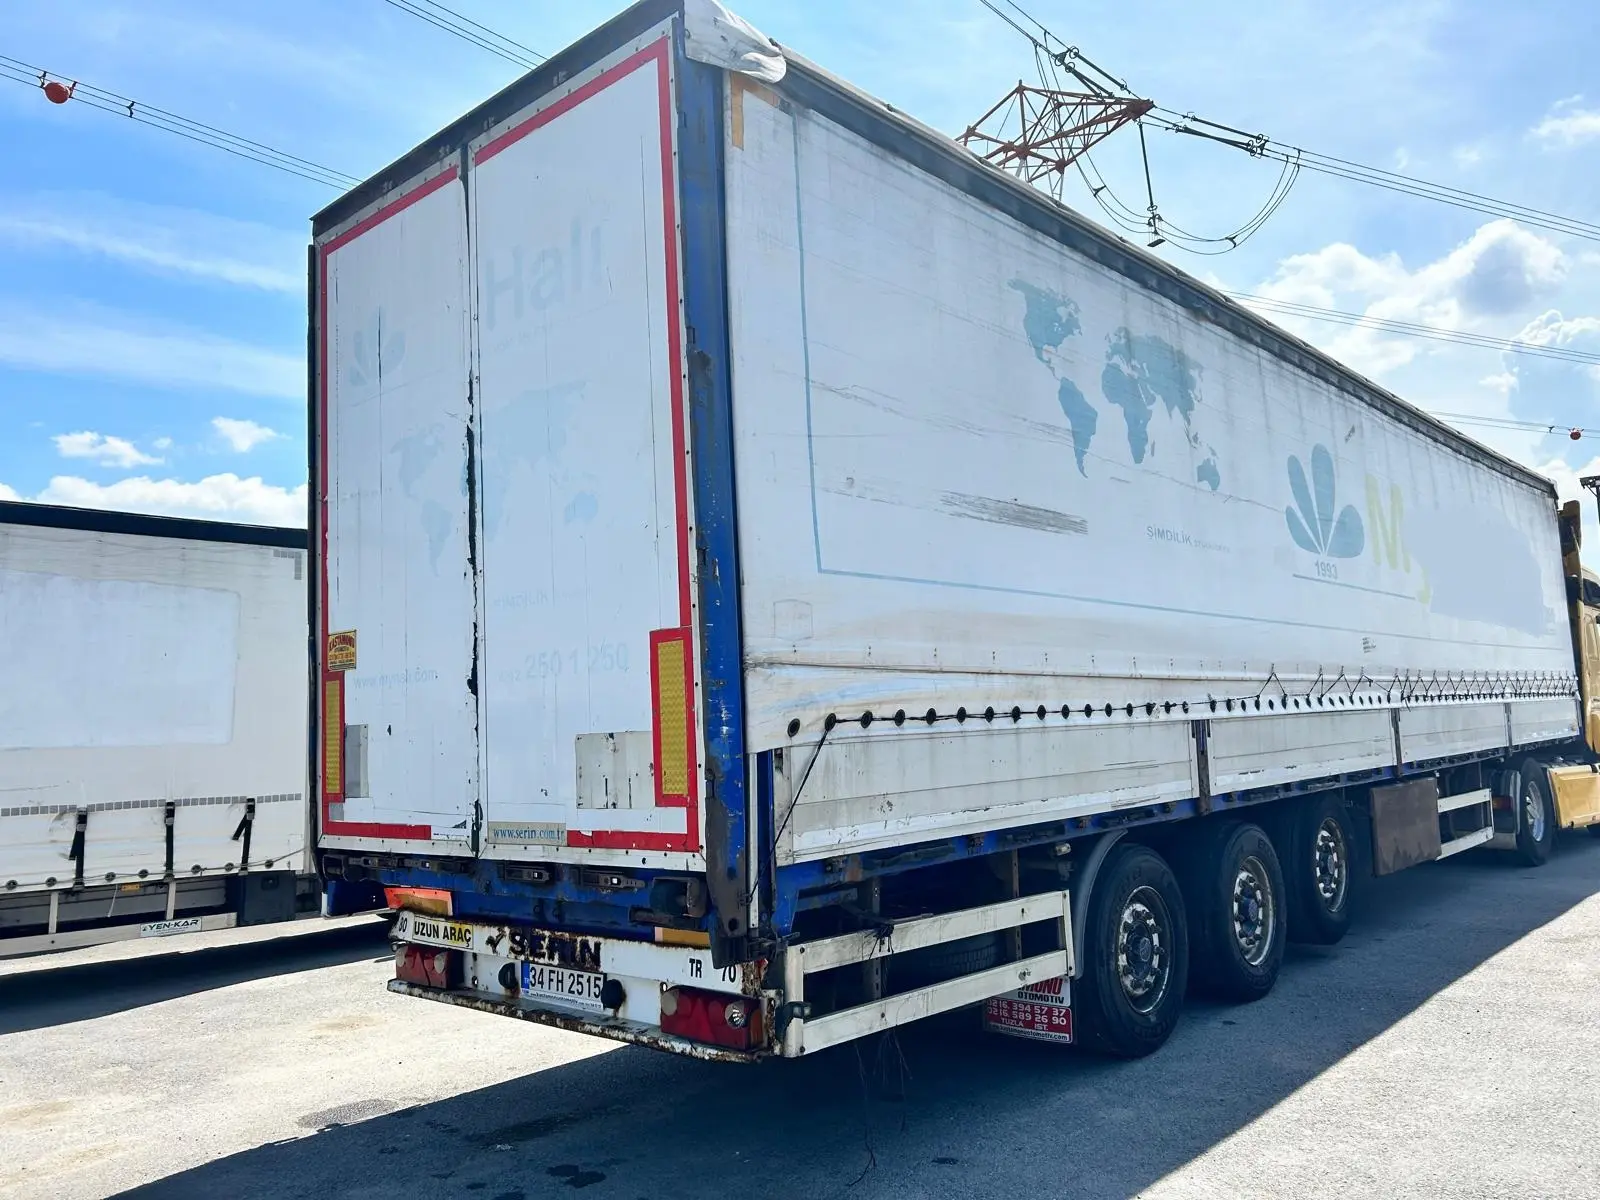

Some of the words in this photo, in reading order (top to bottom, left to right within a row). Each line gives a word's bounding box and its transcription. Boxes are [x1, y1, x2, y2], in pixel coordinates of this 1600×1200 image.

[1314, 559, 1339, 580] 1993
[493, 826, 565, 842] www.serin.com.tr
[149, 919, 198, 930] YEN-KAR
[414, 921, 440, 939] UZUN
[442, 926, 472, 948] ARAÇ
[688, 957, 703, 979] TR
[529, 966, 544, 989] 34
[548, 970, 564, 993] FH
[567, 972, 602, 999] 2515
[1012, 1002, 1031, 1013] 394
[1034, 1005, 1048, 1014] 57
[1052, 1008, 1066, 1017] 37
[1001, 1017, 1024, 1028] TUZLA
[1012, 1011, 1031, 1021] 589
[1034, 1014, 1048, 1023] 26
[1052, 1016, 1067, 1026] 90
